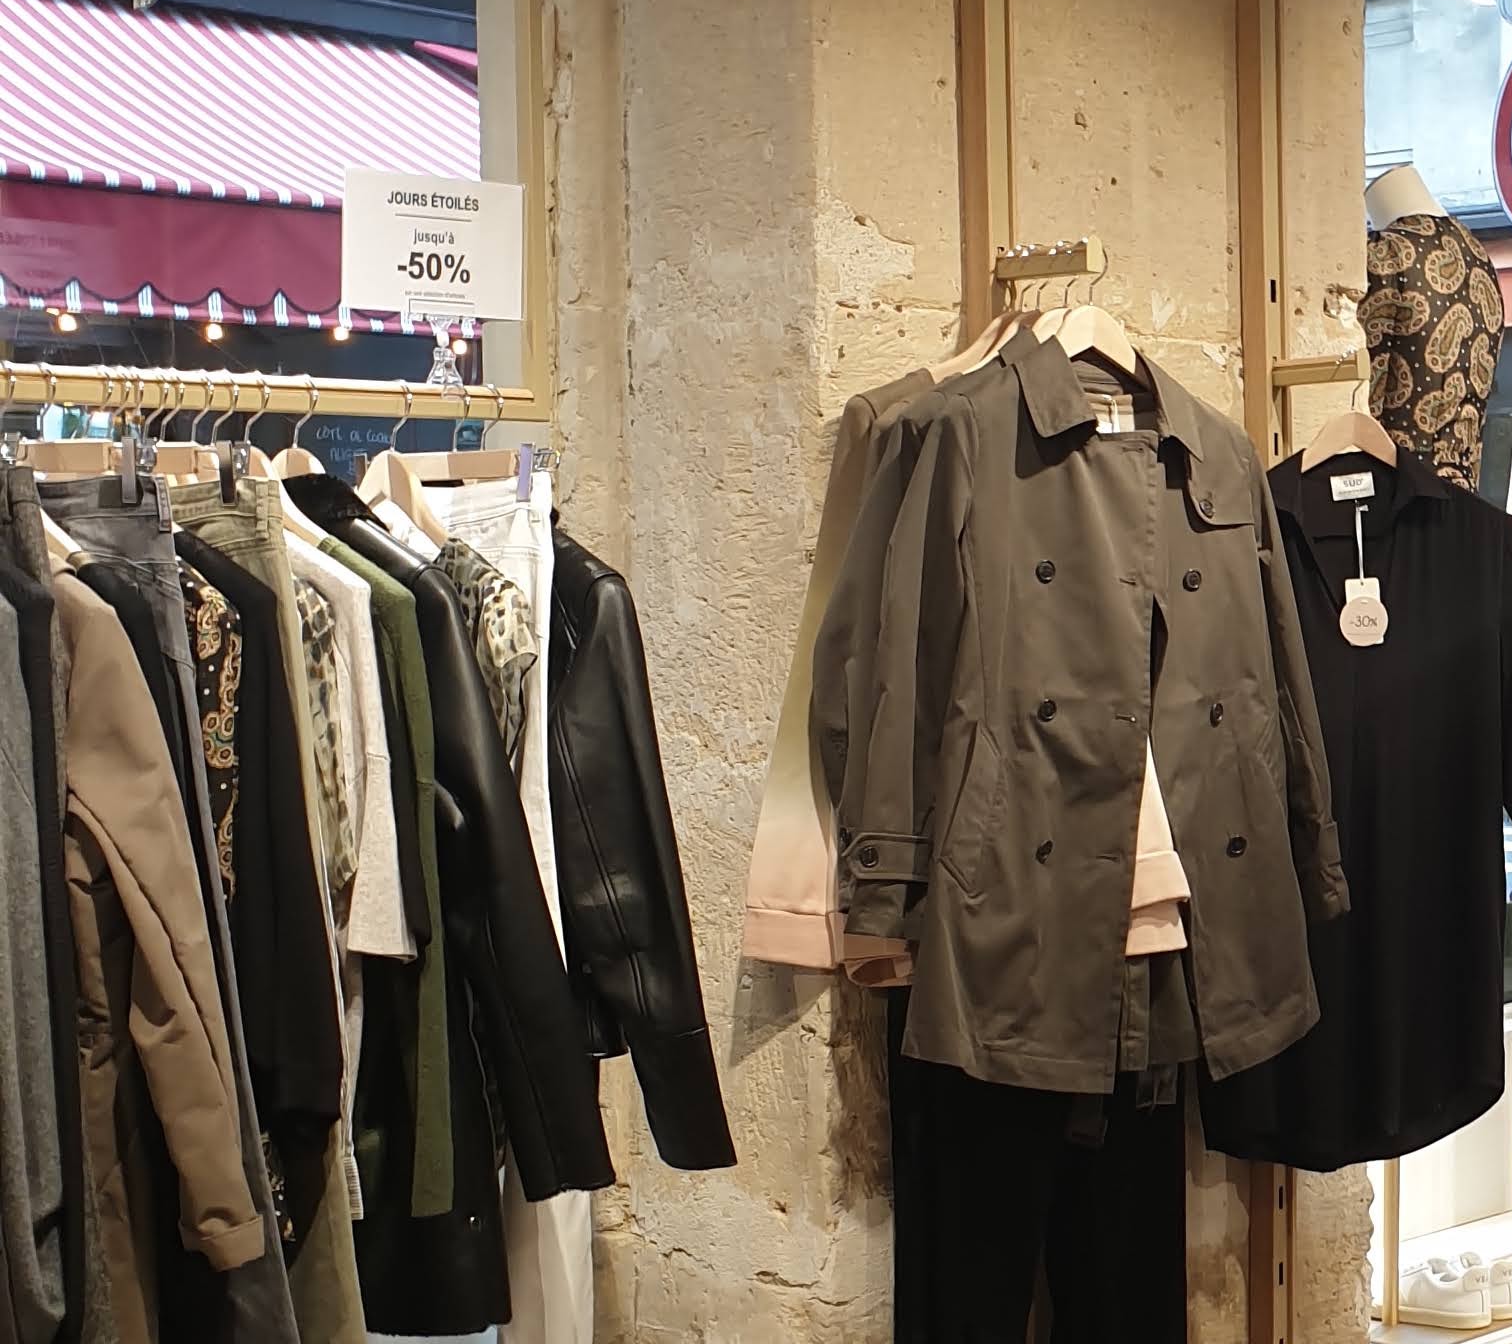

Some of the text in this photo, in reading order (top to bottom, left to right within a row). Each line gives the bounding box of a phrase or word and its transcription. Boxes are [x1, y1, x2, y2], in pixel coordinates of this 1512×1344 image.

[387, 190, 480, 212] JOURS ÉTOILÉS
[397, 251, 471, 284] -50%
[1350, 615, 1378, 628] -30%
